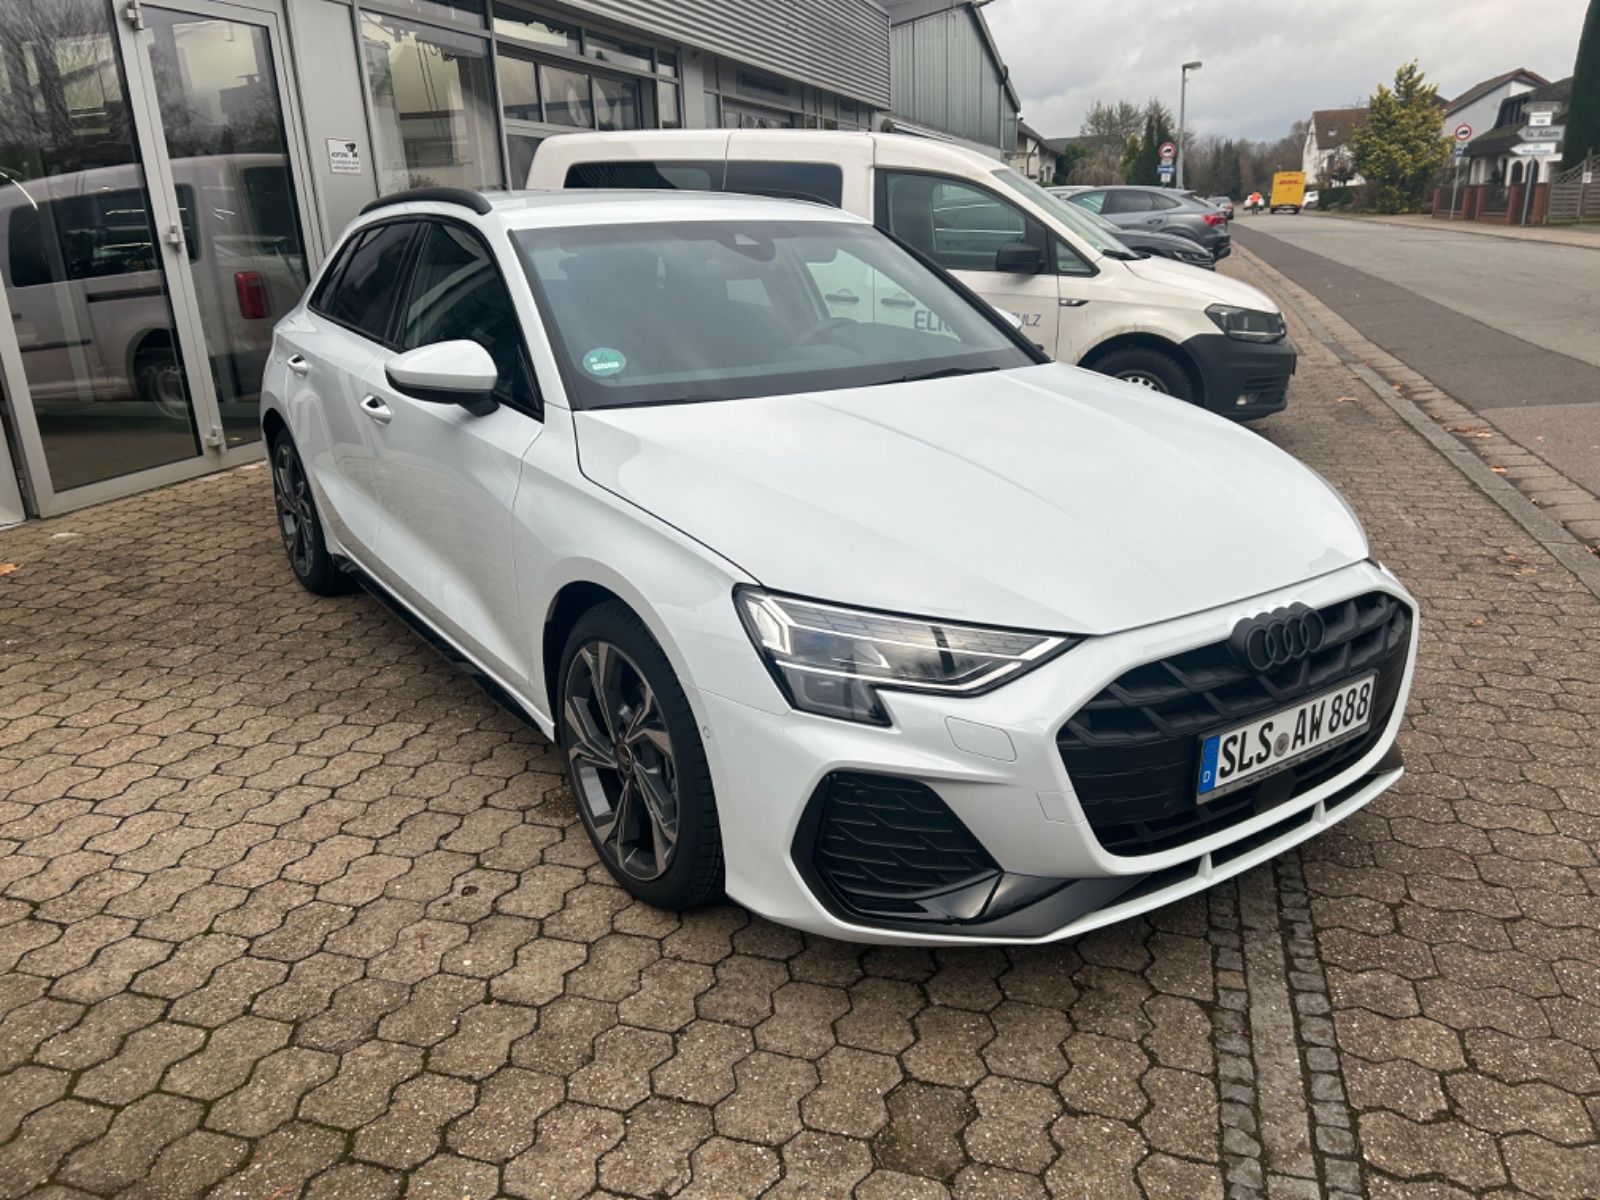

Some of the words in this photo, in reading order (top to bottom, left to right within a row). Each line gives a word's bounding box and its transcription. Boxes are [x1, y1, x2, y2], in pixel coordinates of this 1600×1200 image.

[1219, 721, 1274, 779] SLS
[1291, 699, 1326, 751] AW
[1328, 682, 1371, 734] 888
[1202, 770, 1211, 783] D
